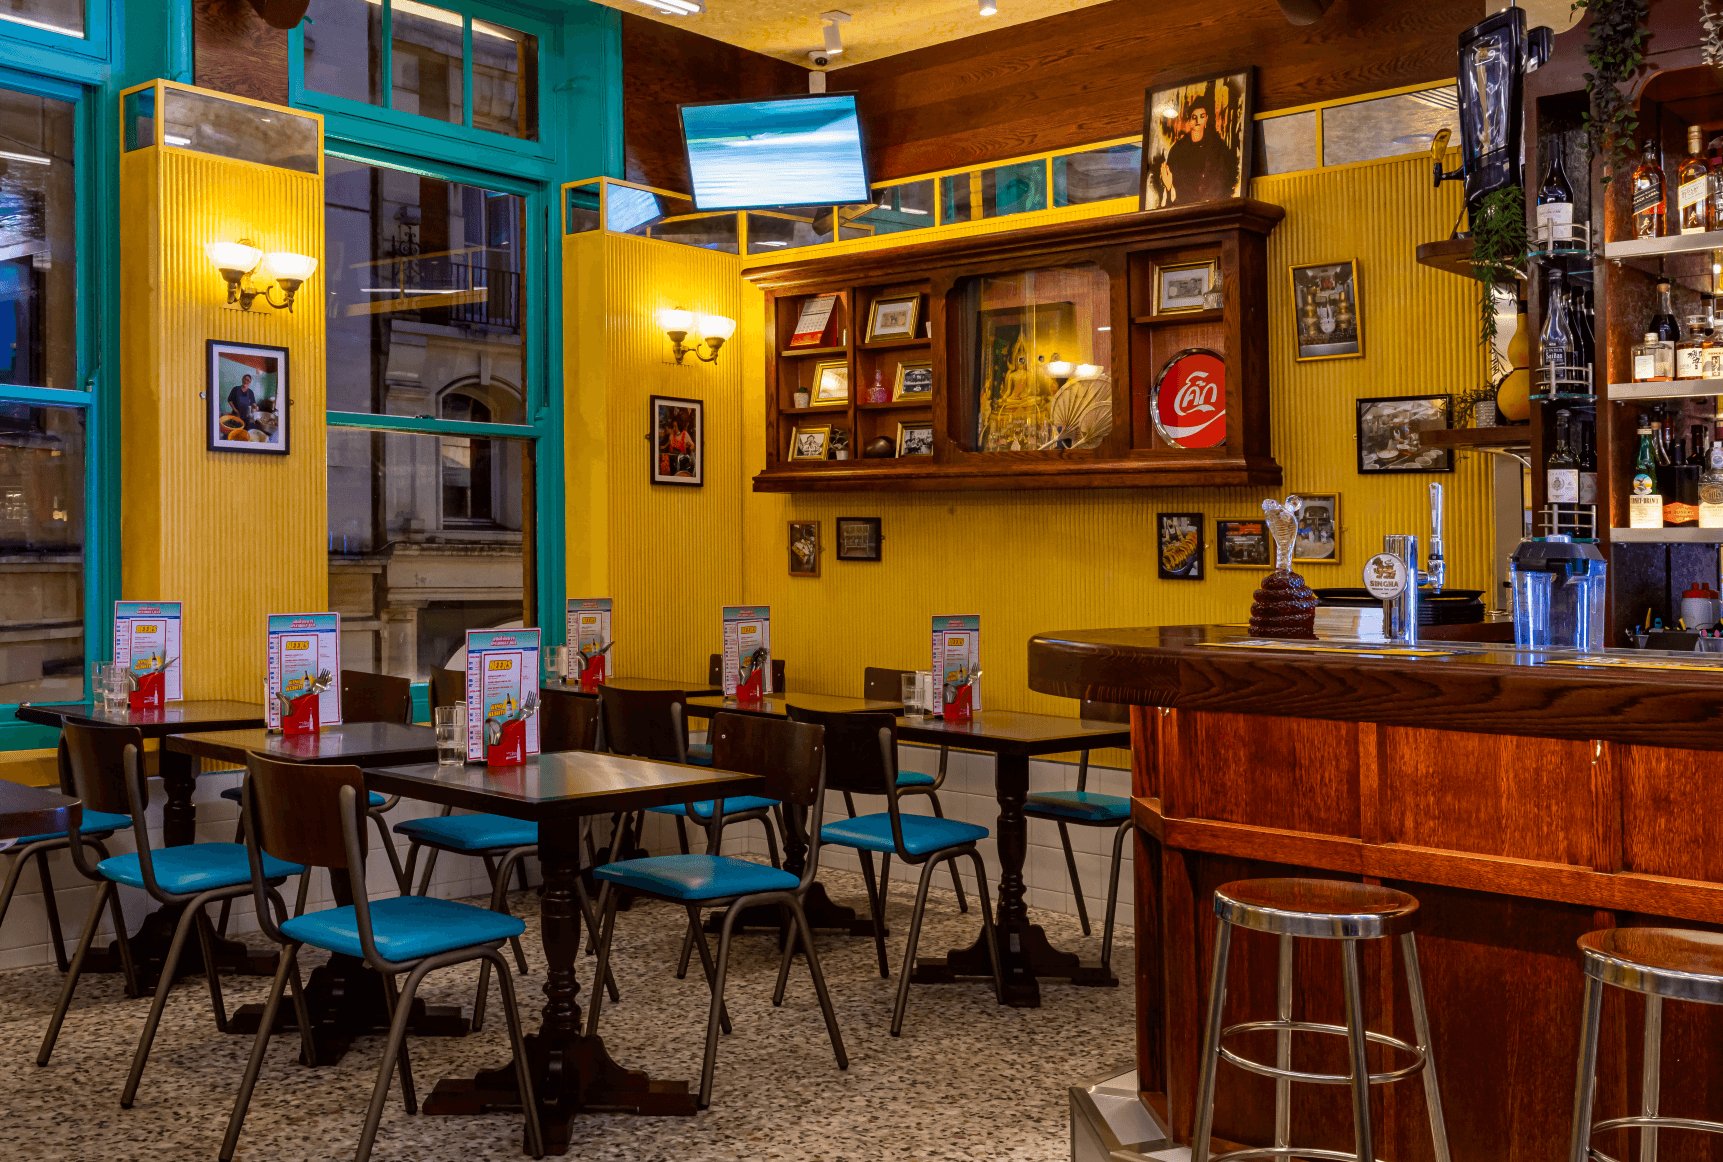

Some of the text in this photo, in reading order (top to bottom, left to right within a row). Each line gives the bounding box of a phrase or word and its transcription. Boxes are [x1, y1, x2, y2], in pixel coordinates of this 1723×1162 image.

[1370, 580, 1398, 588] SINGHA
[136, 625, 157, 633] BEERS
[286, 641, 309, 650] BEERS
[488, 660, 512, 671] BEERS
